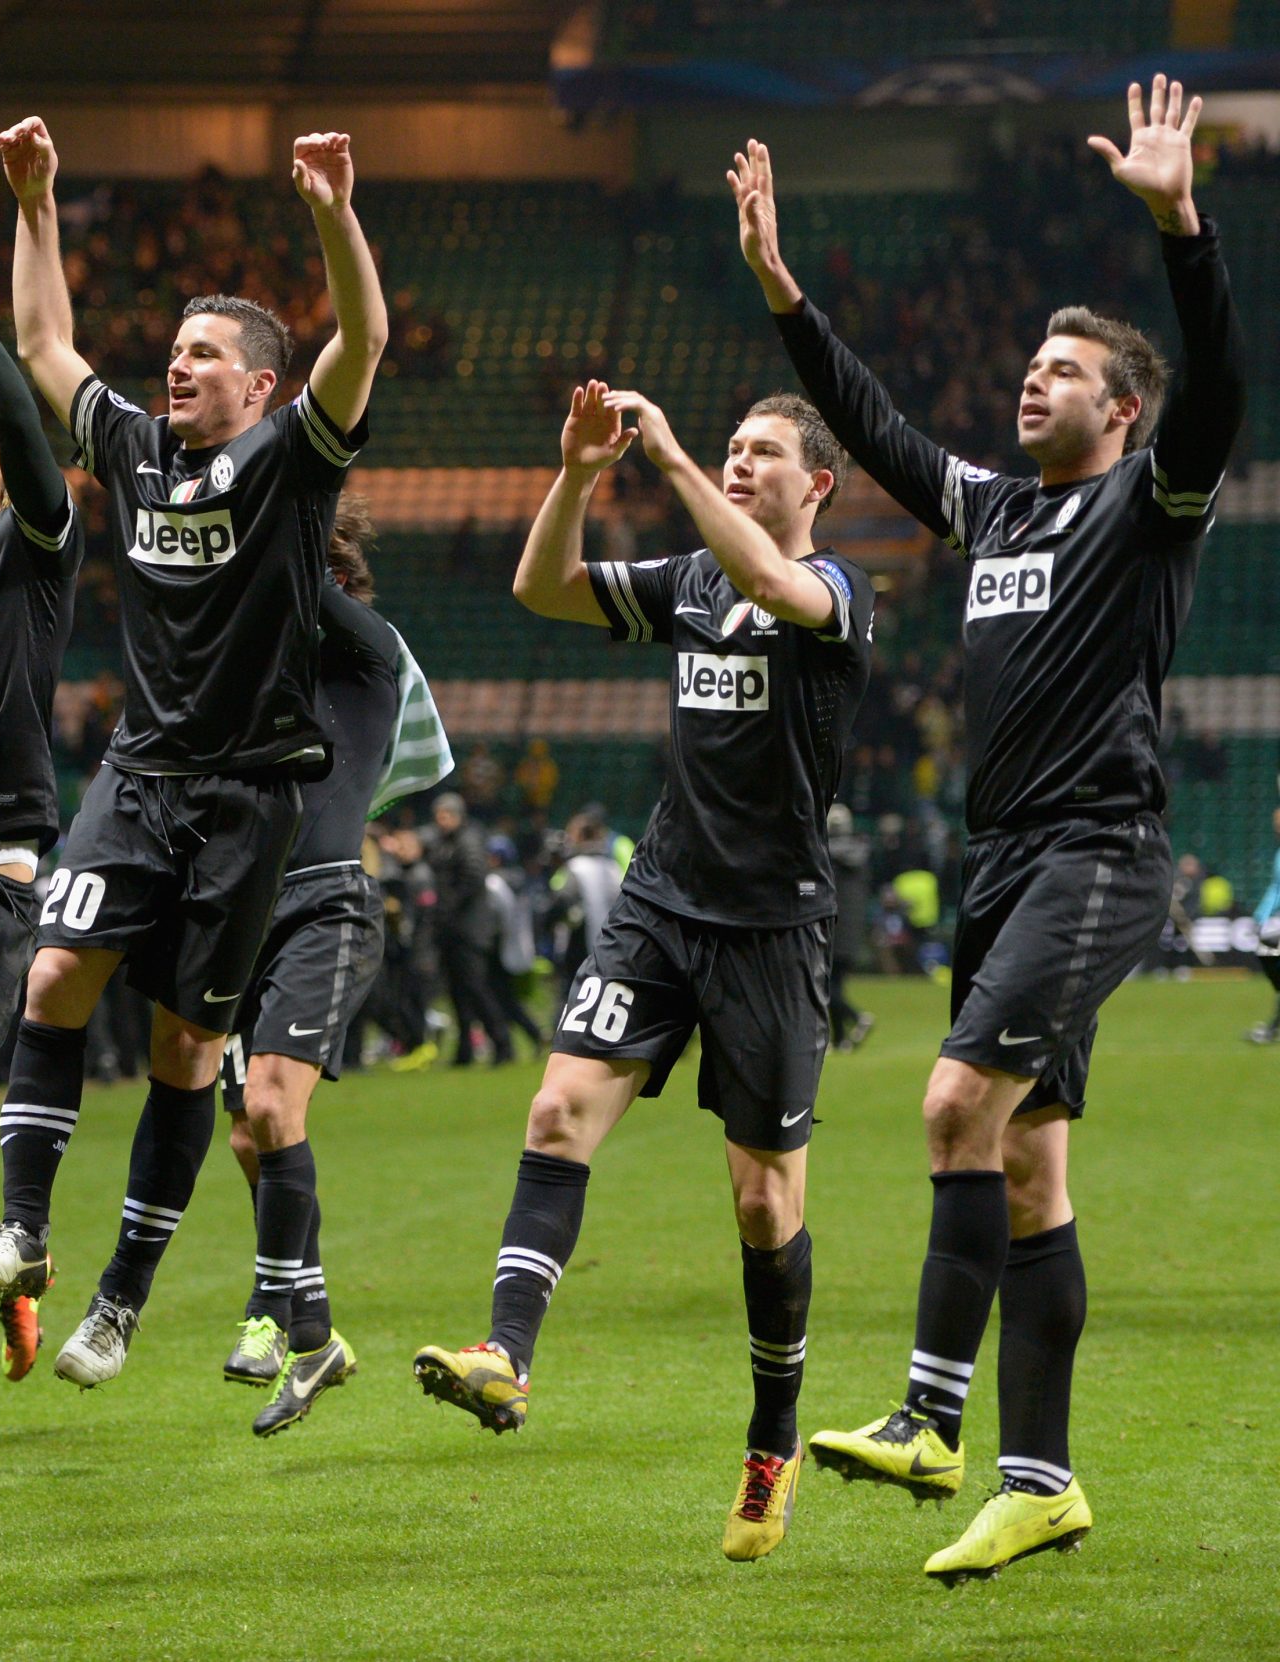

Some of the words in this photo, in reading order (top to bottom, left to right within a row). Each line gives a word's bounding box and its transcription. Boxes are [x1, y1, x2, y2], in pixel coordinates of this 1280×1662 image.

[138, 512, 231, 564] Jeep
[680, 655, 765, 709] Jeep
[38, 867, 106, 931] 20
[561, 976, 635, 1043] 26
